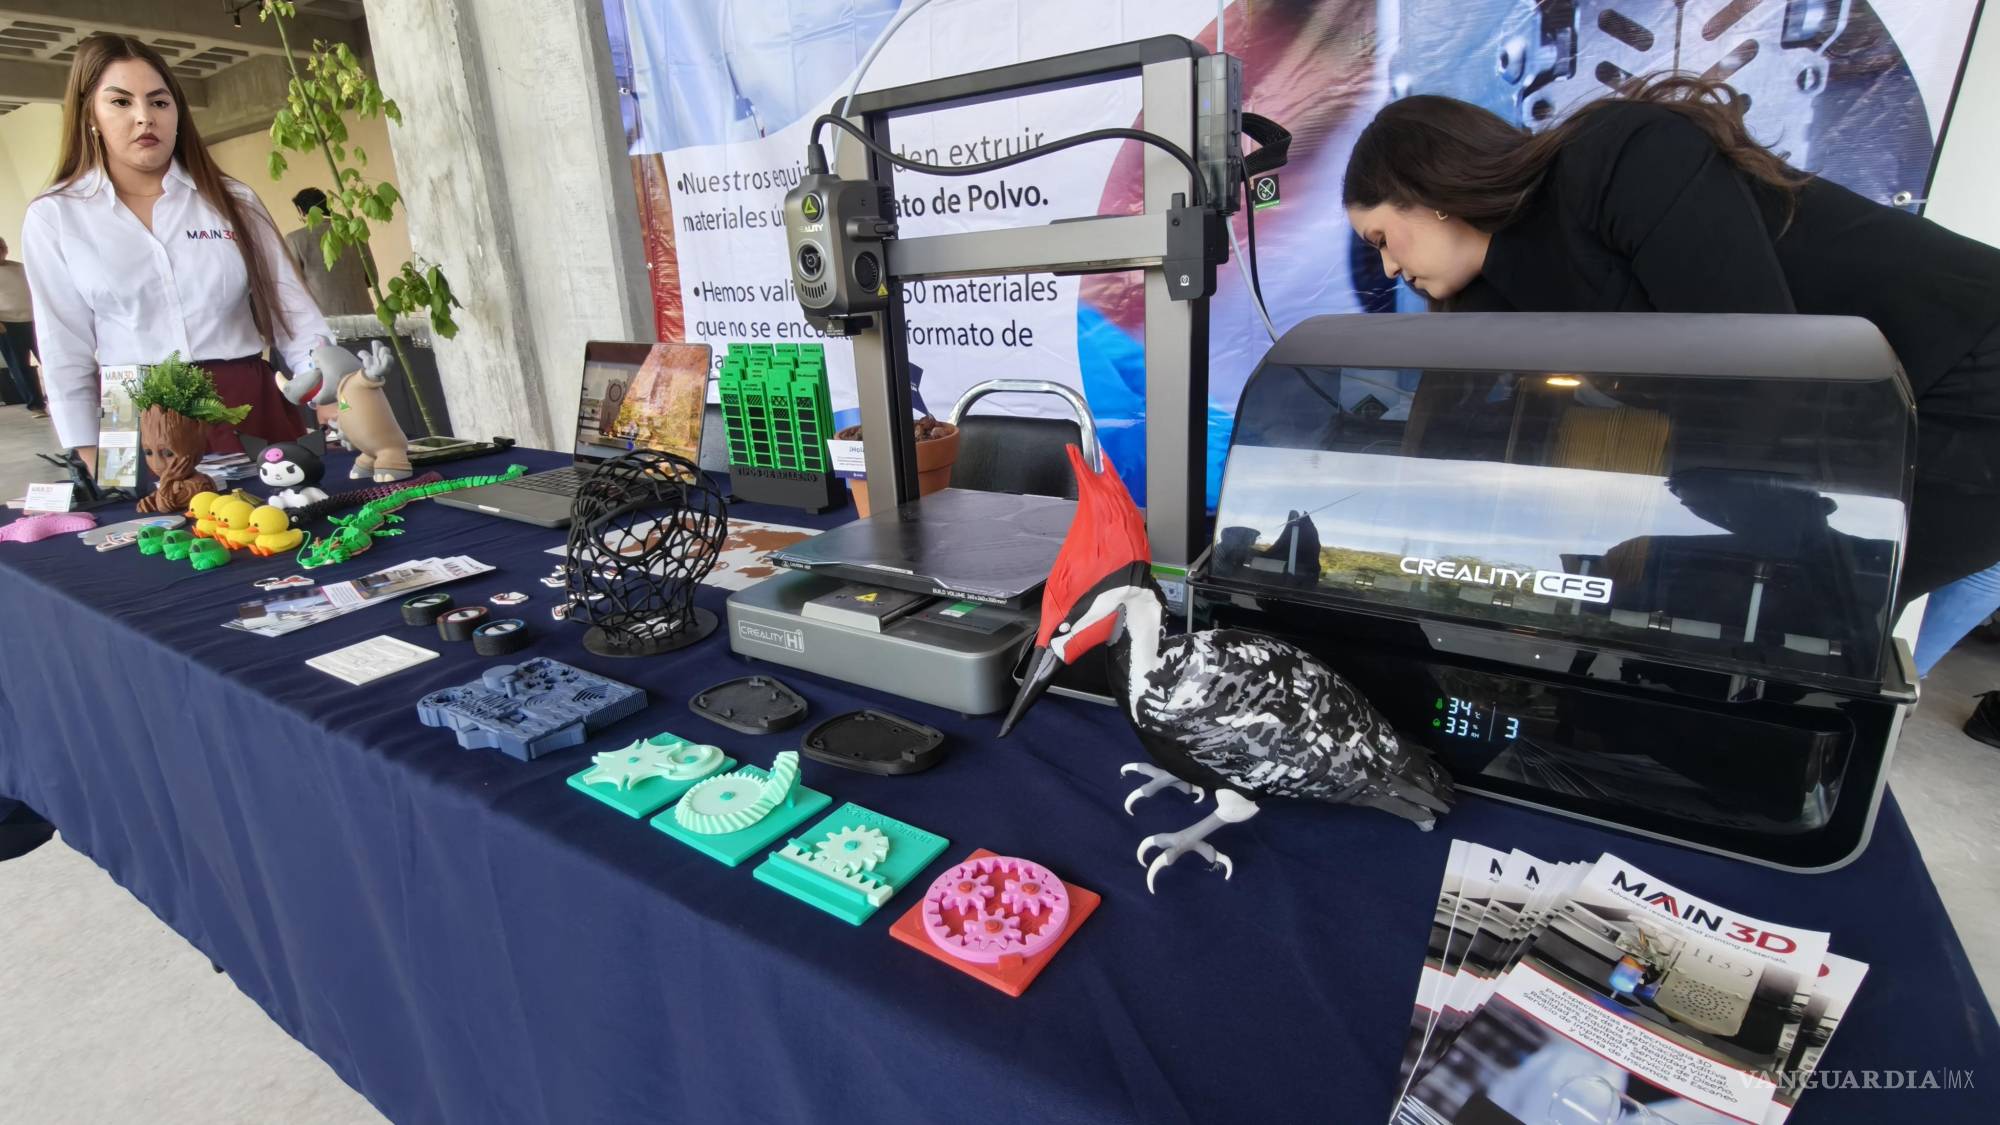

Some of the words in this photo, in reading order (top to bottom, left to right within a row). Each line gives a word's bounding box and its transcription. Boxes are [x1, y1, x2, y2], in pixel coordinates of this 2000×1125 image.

[683, 168, 771, 195] Nuestros
[773, 160, 809, 191] equi
[893, 143, 939, 173] den
[949, 126, 1045, 166] extruir
[683, 205, 768, 233] materiales
[893, 193, 926, 219] ato
[932, 186, 961, 215] de
[967, 180, 1049, 212] Polvo.
[702, 280, 755, 302] Hemos
[760, 278, 794, 302] vali
[933, 273, 1058, 303] materiales
[696, 320, 727, 342] que
[729, 321, 747, 337] no
[751, 322, 771, 338] se
[904, 319, 994, 346] formato
[1002, 319, 1033, 347] de
[1400, 556, 1531, 589] CREALITY
[1540, 576, 1606, 599] CFS
[740, 626, 784, 642] CREALITY
[786, 629, 803, 650] Hi
[1448, 697, 1472, 717] 34
[1445, 716, 1469, 737] 33
[1504, 717, 1519, 739] 3
[1607, 887, 1647, 909] Advanced
[1704, 933, 1741, 950] printing
[1726, 921, 1797, 954] 3D
[1697, 1058, 1712, 1069] 3D
